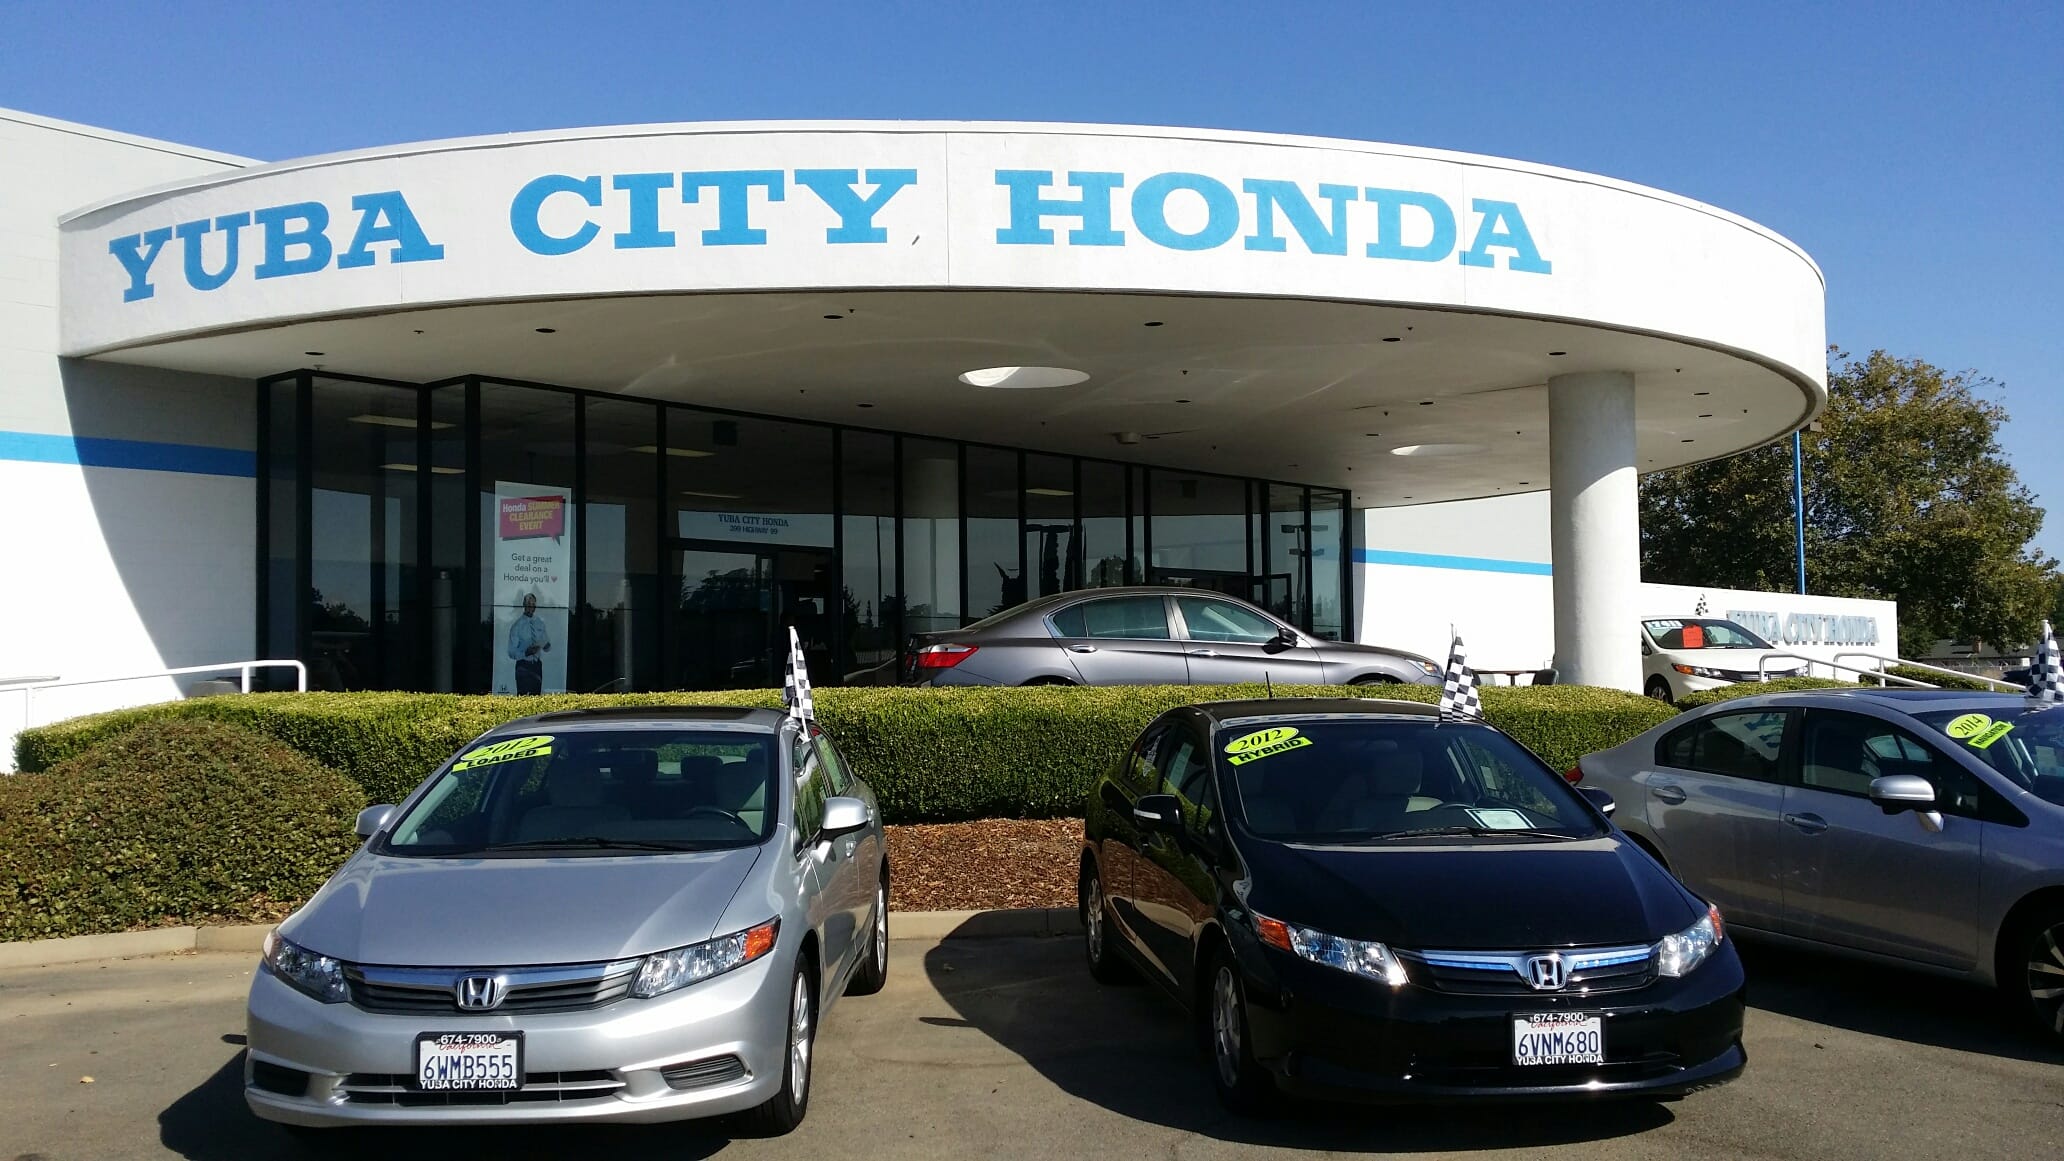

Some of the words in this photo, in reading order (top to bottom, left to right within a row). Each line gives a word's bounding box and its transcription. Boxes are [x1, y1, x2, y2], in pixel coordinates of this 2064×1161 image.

[110, 191, 445, 302] YUBA
[510, 169, 917, 256] CITY
[995, 169, 1552, 274] HONDA
[503, 503, 526, 512] Honda
[509, 511, 553, 521] CLEARANCE
[742, 516, 760, 525] CITY
[762, 517, 789, 527] HONDA
[520, 520, 544, 530] EVENT
[511, 553, 525, 562] Get
[533, 556, 553, 564] great
[514, 564, 531, 572] deal
[503, 573, 529, 582] Honda
[1955, 715, 1984, 736] 2014
[1237, 729, 1283, 751] 2012
[475, 737, 538, 758] 2012
[1238, 740, 1302, 762] HYBRID
[467, 749, 537, 768] LOADED
[1533, 1012, 1584, 1023] 674-7900
[440, 1034, 497, 1044] 674-7900
[1518, 1030, 1599, 1056] 6VNM680
[1544, 1055, 1566, 1065] CITY
[1568, 1053, 1604, 1064] HONDA
[424, 1055, 513, 1079] 6WMB555
[451, 1079, 476, 1089] CITY
[478, 1079, 518, 1089] HONDA
